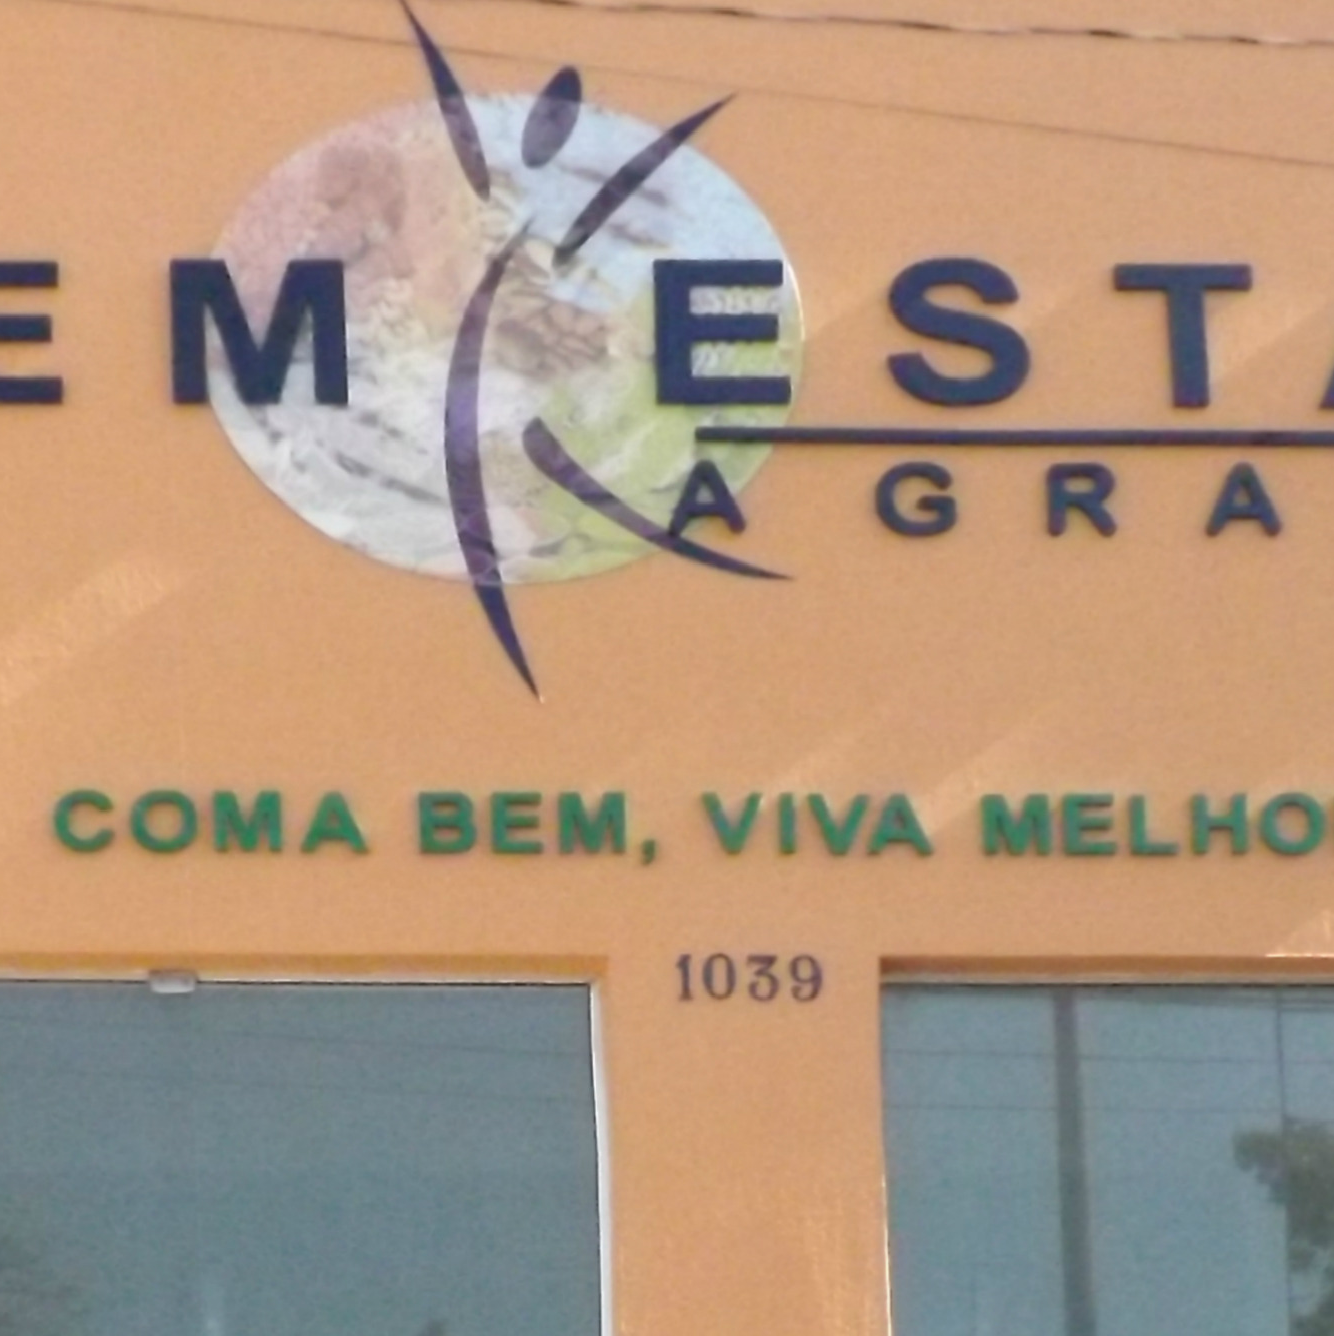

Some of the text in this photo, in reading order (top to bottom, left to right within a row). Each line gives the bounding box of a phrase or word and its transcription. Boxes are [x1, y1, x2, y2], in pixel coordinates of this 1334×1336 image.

[672, 459, 746, 535] A
[53, 789, 371, 856] COMA
[417, 790, 659, 867] BEM,
[700, 791, 933, 857] VIVA
[673, 951, 825, 1004] 1039
